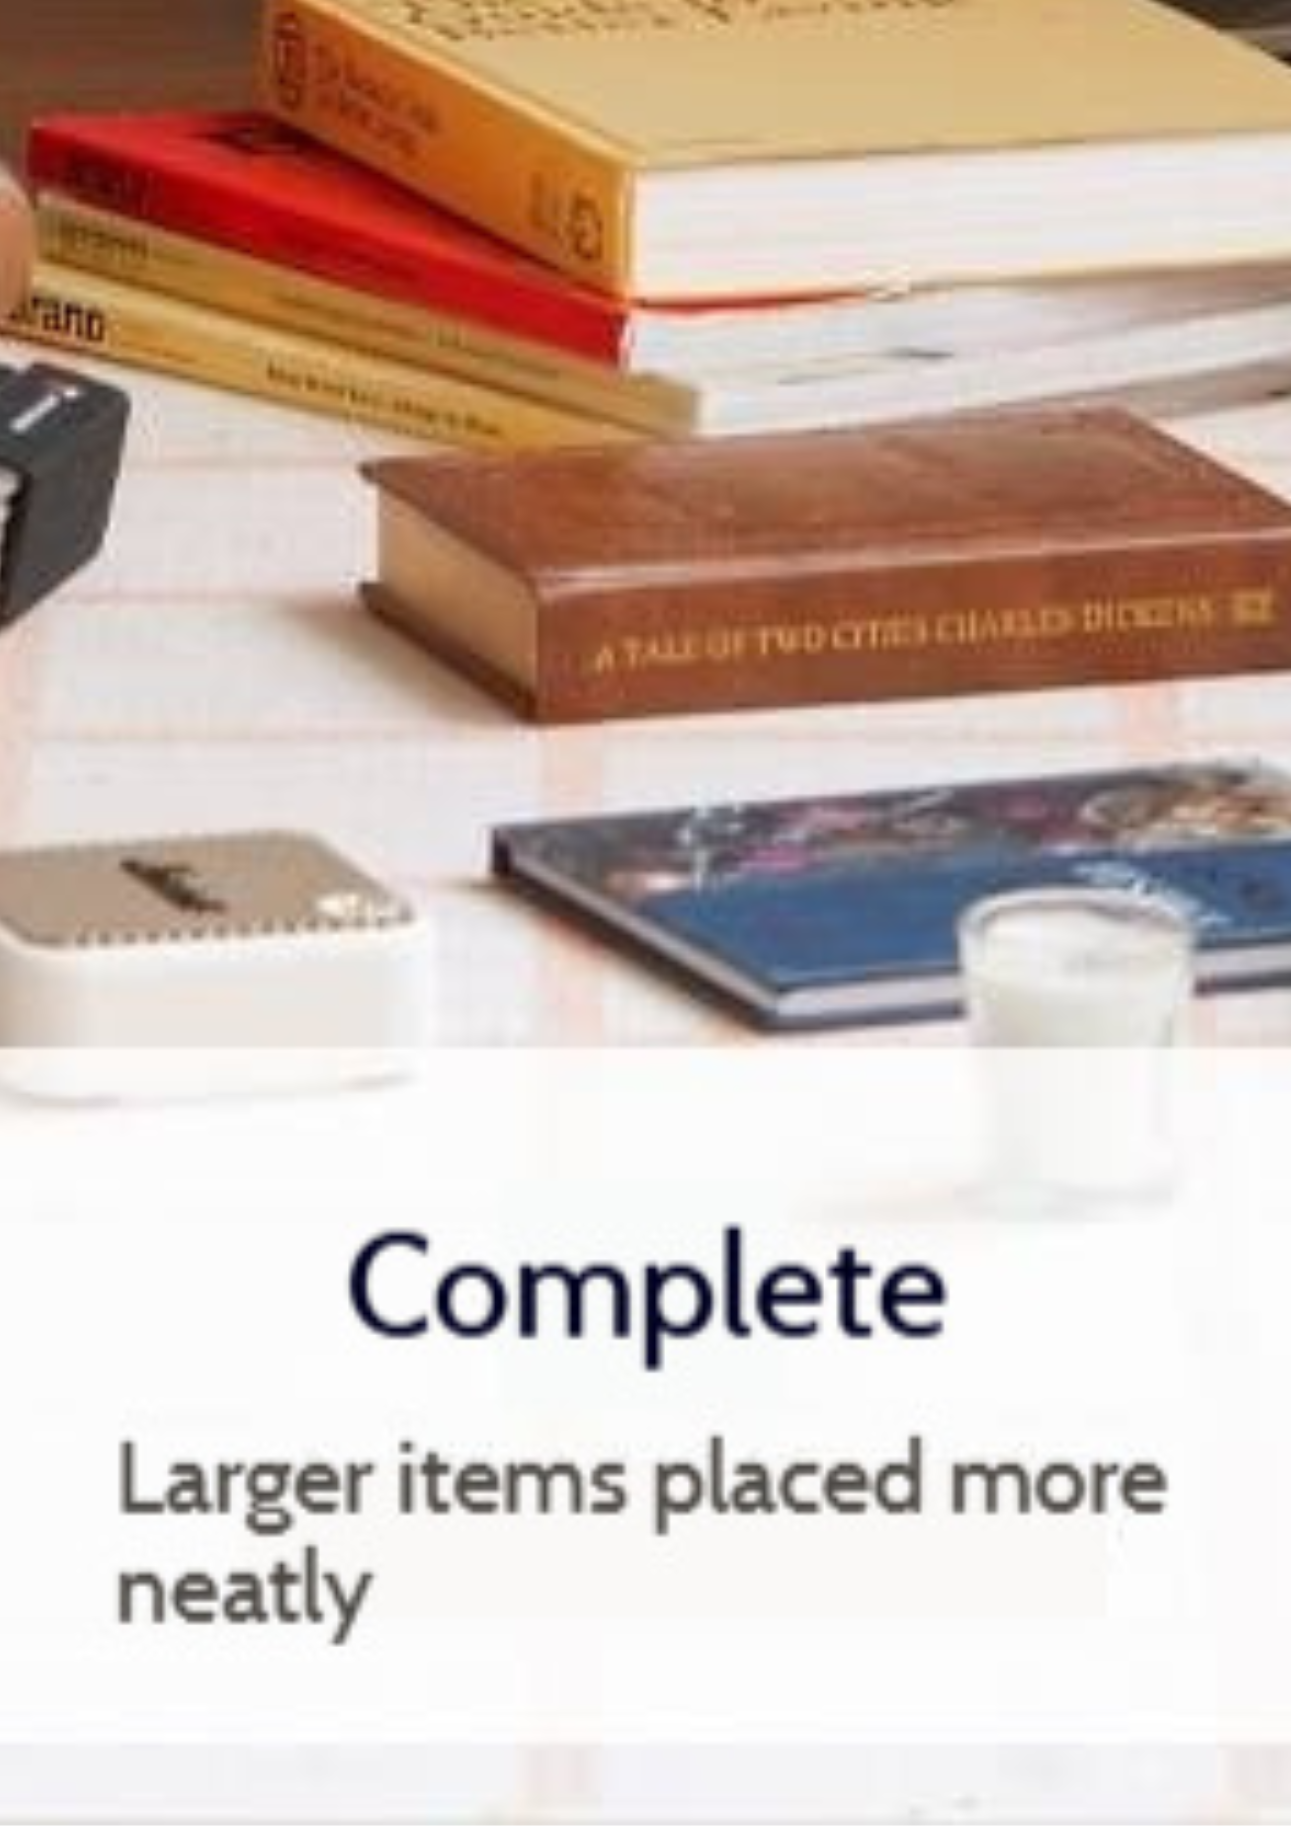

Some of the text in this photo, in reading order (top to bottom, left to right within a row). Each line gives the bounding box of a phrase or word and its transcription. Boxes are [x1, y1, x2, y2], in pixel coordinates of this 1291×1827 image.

[594, 642, 615, 673] A
[758, 622, 825, 658] TWO
[1083, 595, 1215, 635] DICKENS
